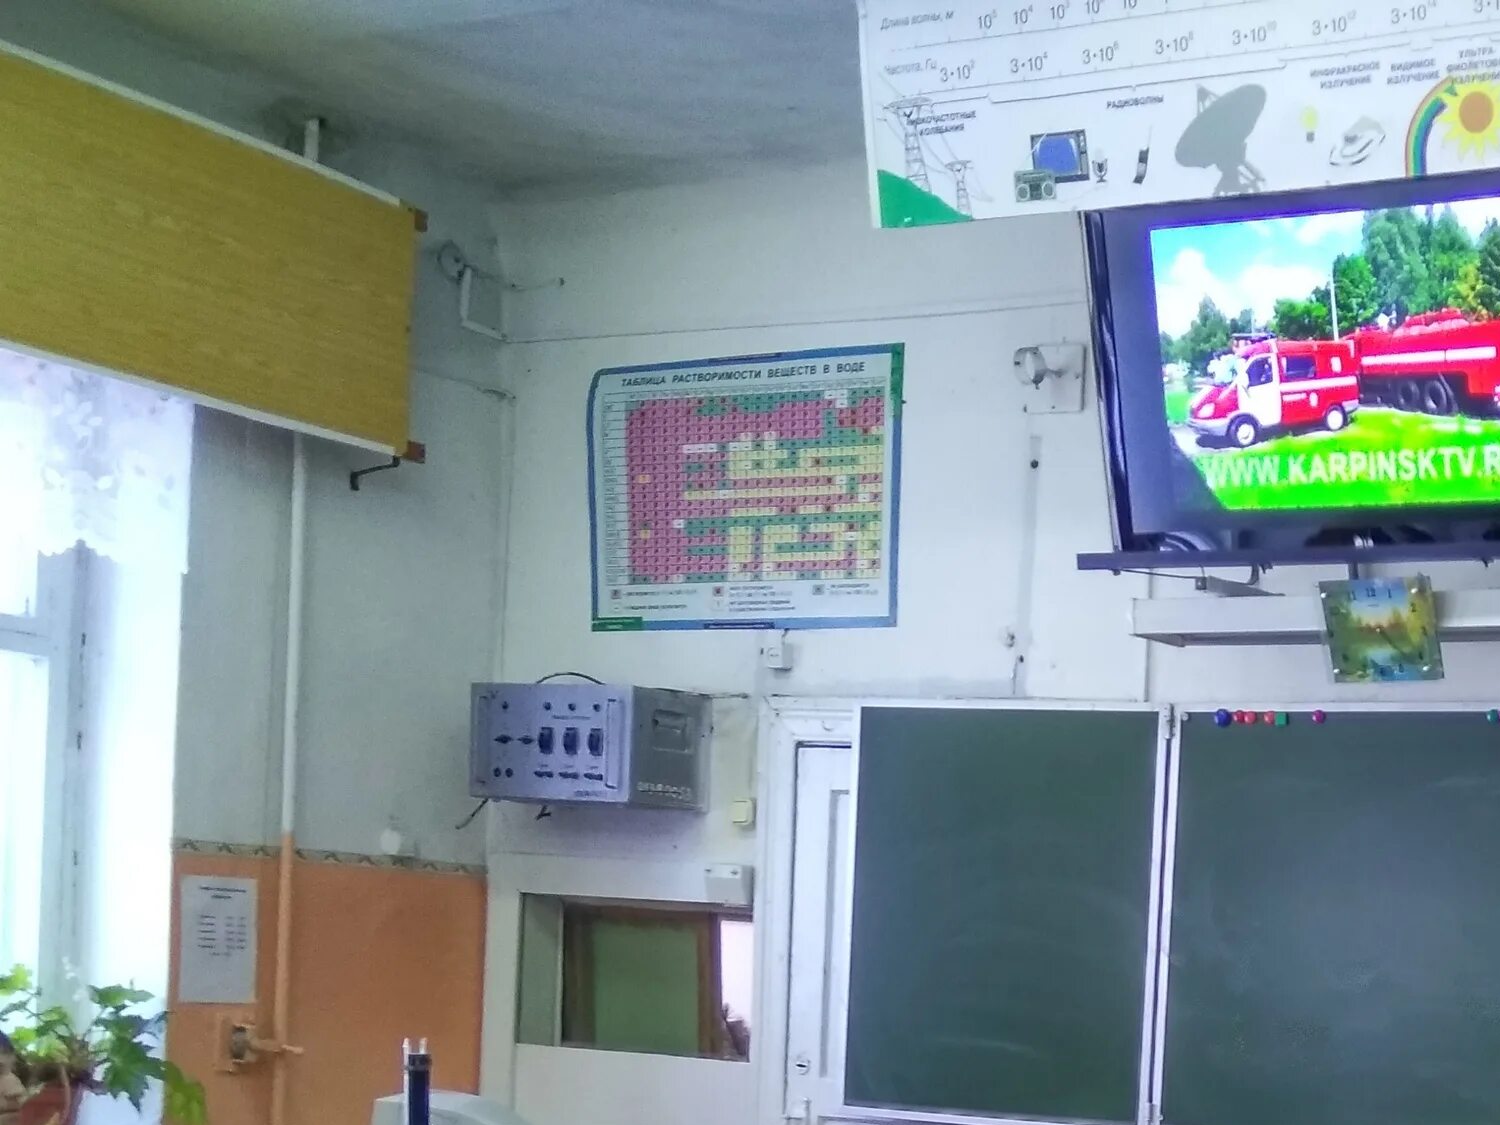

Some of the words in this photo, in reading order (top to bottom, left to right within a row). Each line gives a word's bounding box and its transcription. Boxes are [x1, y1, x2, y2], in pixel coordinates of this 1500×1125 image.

[1310, 61, 1380, 78] ИНФРАКРАСНОЕ
[1390, 58, 1437, 72] ВИДИМОЕ
[1320, 75, 1372, 89] ИЗЛУЧЕНИЕ
[1387, 70, 1440, 85] ИЗЛУЧЕНИЕ
[1106, 95, 1164, 109] РАДИОВОЛНЫ
[621, 376, 666, 388] ТАБЛИЦА
[671, 369, 762, 384] РАСТВОРИМОСТИ
[767, 365, 817, 379] ВЕЩЕСТВ
[823, 363, 830, 374] В
[836, 361, 866, 374] ВОДЕ
